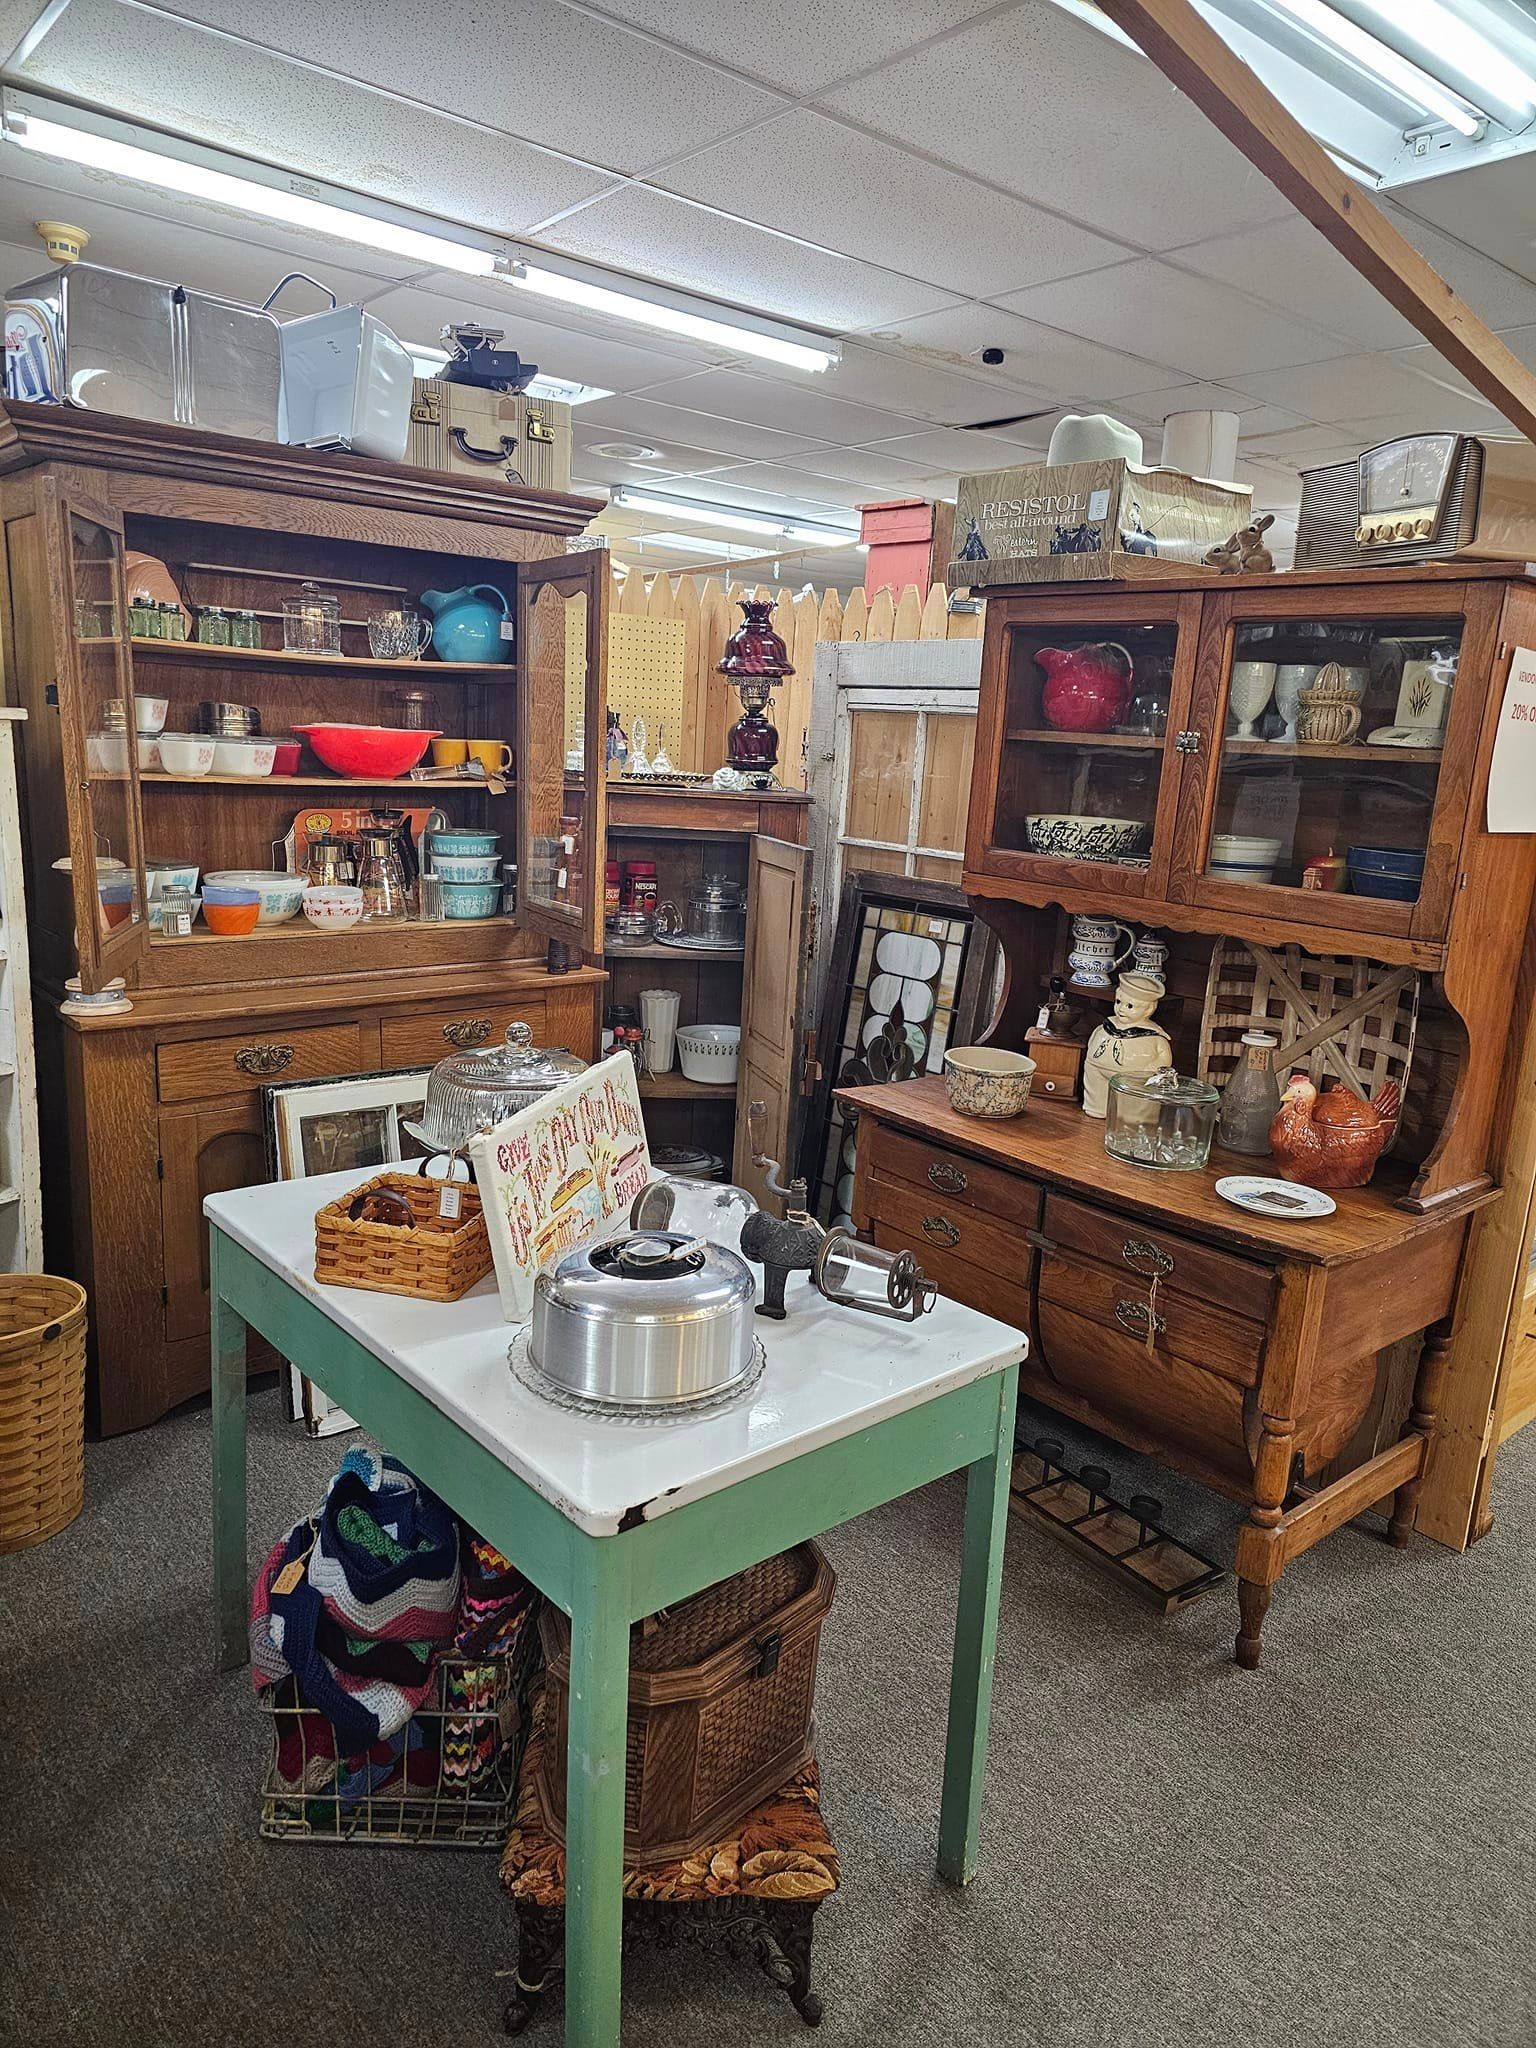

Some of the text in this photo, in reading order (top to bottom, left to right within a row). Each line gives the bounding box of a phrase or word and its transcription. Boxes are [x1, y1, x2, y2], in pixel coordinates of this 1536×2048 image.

[980, 493, 1087, 520] RESISTOL
[984, 519, 1008, 531] best
[993, 533, 1038, 554] Western
[1009, 548, 1038, 559] HATS
[1518, 670, 1536, 685] VENDO
[1511, 703, 1529, 721] 20%
[341, 810, 372, 829] 5 in
[497, 1130, 531, 1175] GIVE
[614, 1163, 648, 1209] BREAD
